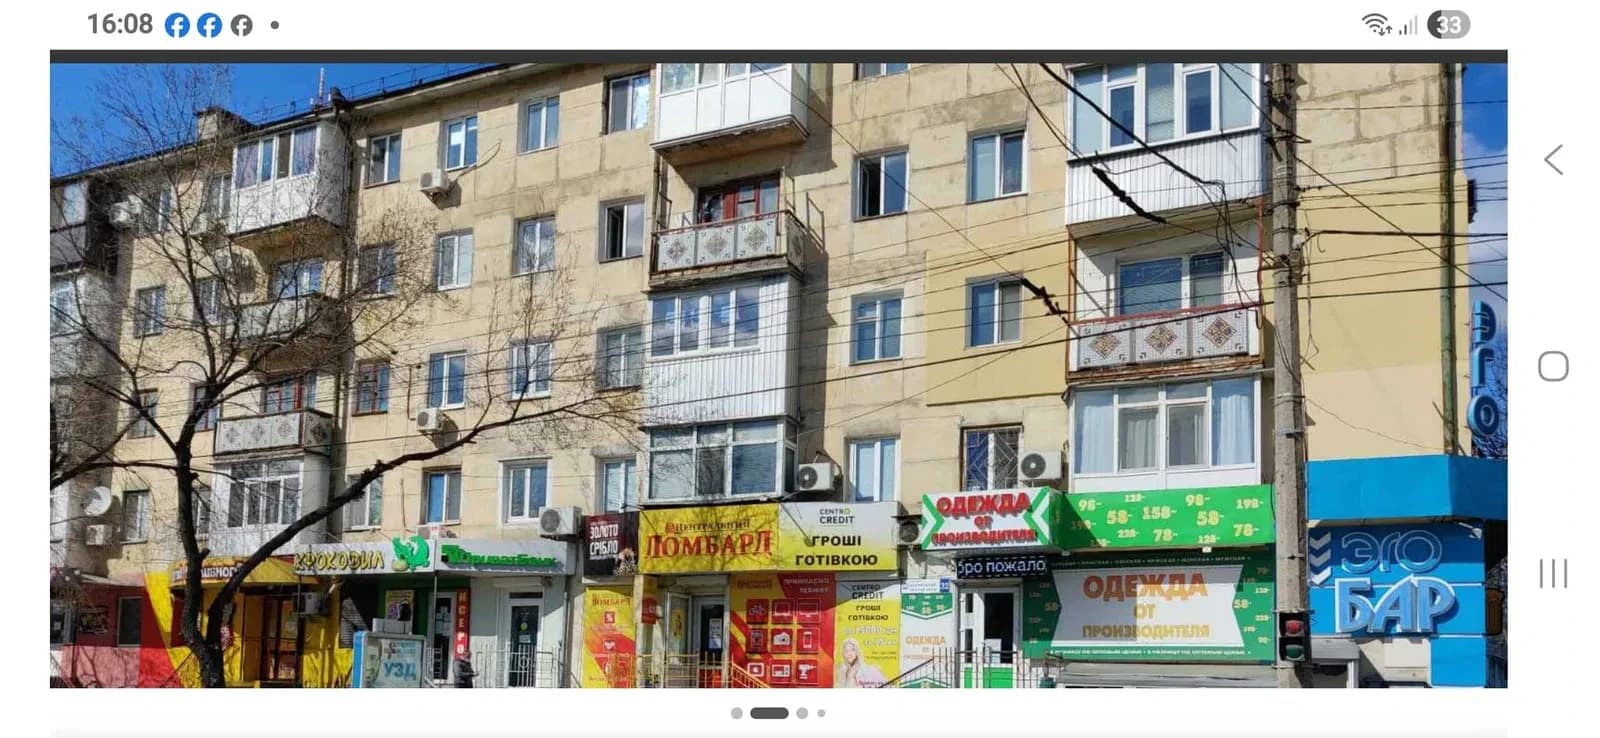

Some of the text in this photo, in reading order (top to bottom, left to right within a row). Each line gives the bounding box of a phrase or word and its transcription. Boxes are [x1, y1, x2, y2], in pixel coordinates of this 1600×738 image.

[936, 492, 1033, 518] ОДЕЖДА
[819, 515, 855, 525] CREDIT
[974, 515, 993, 530] ОТ
[589, 523, 619, 540] ЗОЛОТО
[931, 529, 1037, 545] ПРОИЗВОДИТЕЛЯ
[589, 539, 619, 556] СРІБЛО
[645, 530, 773, 560] ЛОМБАРД
[811, 535, 862, 547] ГРОШІ
[293, 550, 385, 571] КРОКОДИЛ
[795, 554, 878, 567] ГОТІВКОЮ
[852, 591, 883, 600] CREDIT
[1083, 573, 1208, 602] ОДЕЖДА
[1134, 604, 1156, 620] ОТ
[1334, 575, 1458, 634] БАР
[1082, 624, 1210, 640] ПРОИЗВОДИТЕЛЯ
